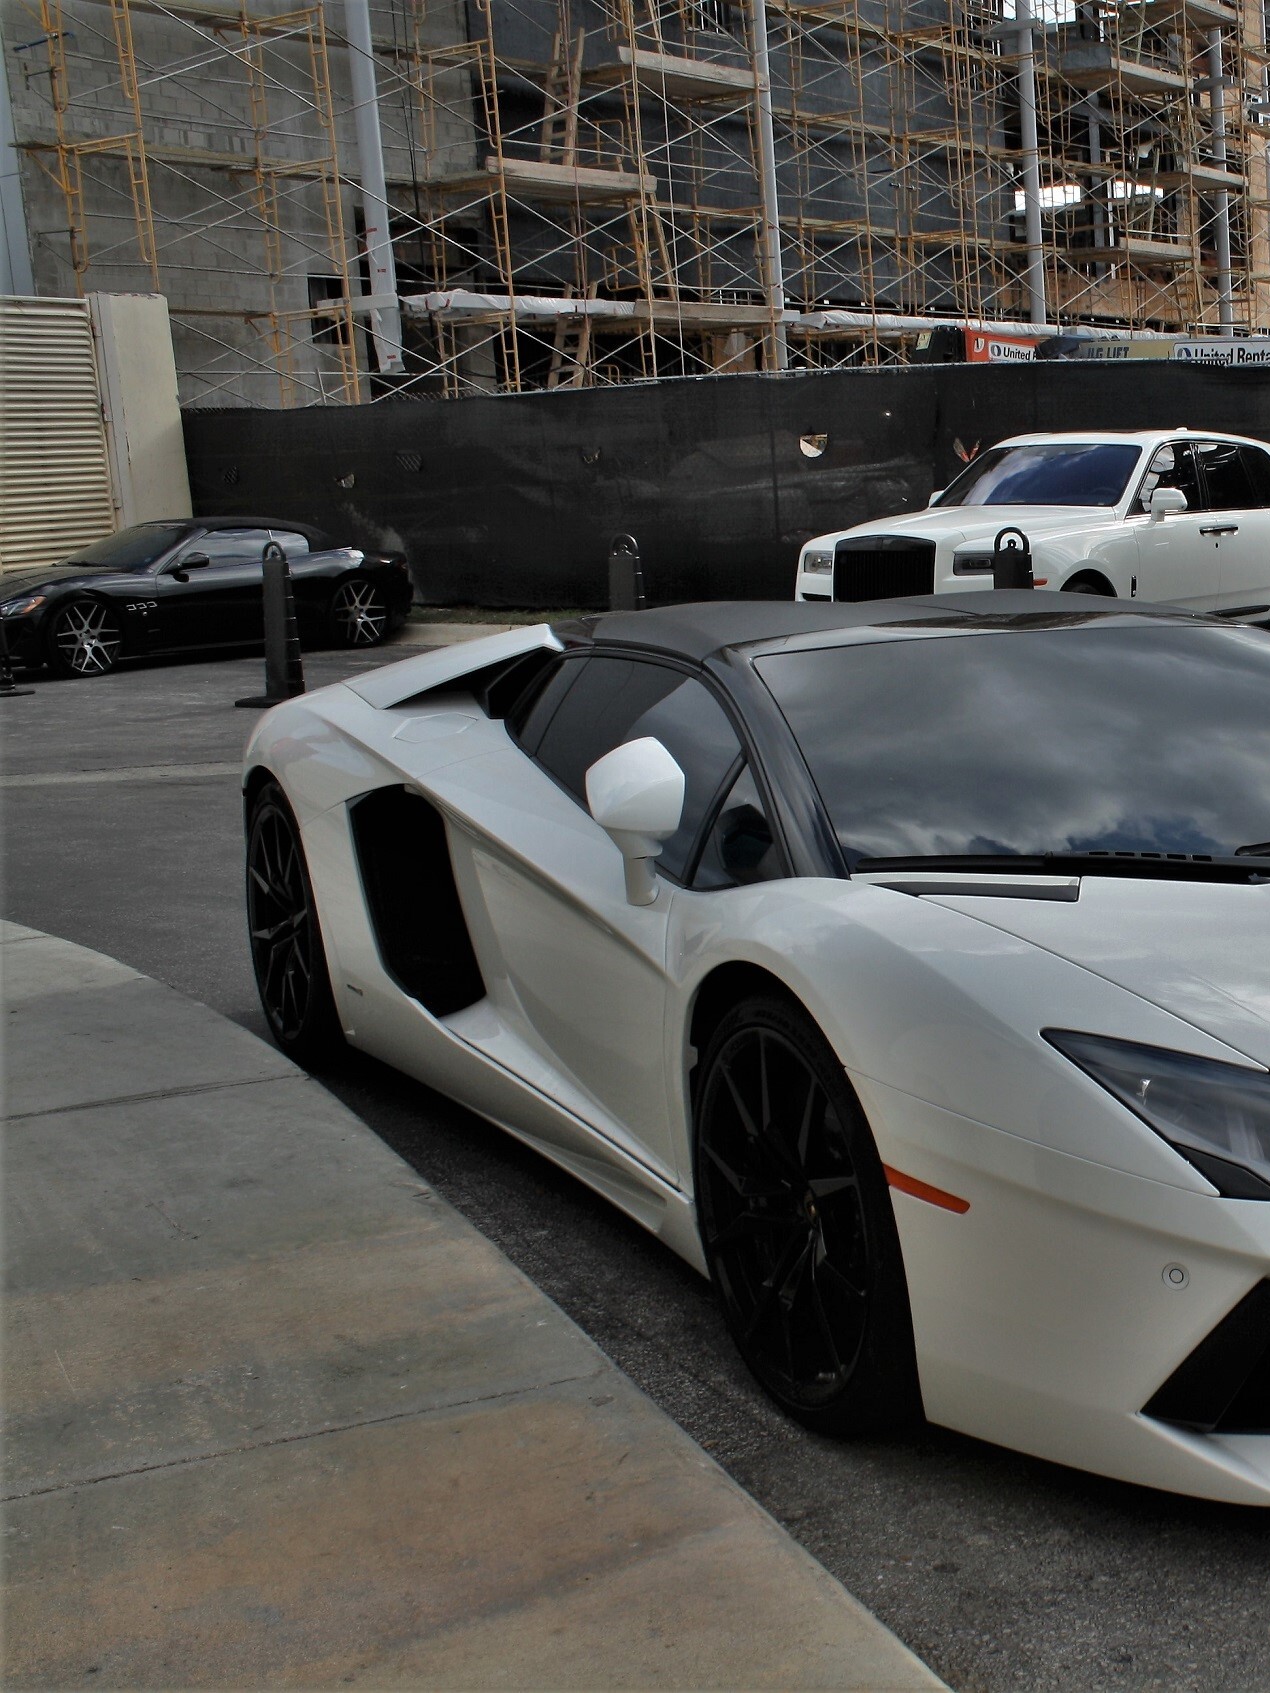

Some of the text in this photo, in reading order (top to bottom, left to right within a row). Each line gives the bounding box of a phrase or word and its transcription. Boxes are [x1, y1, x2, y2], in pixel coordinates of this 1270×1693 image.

[1003, 347, 1031, 360] United
[1107, 346, 1130, 358] LIFT
[1195, 348, 1233, 365] United
